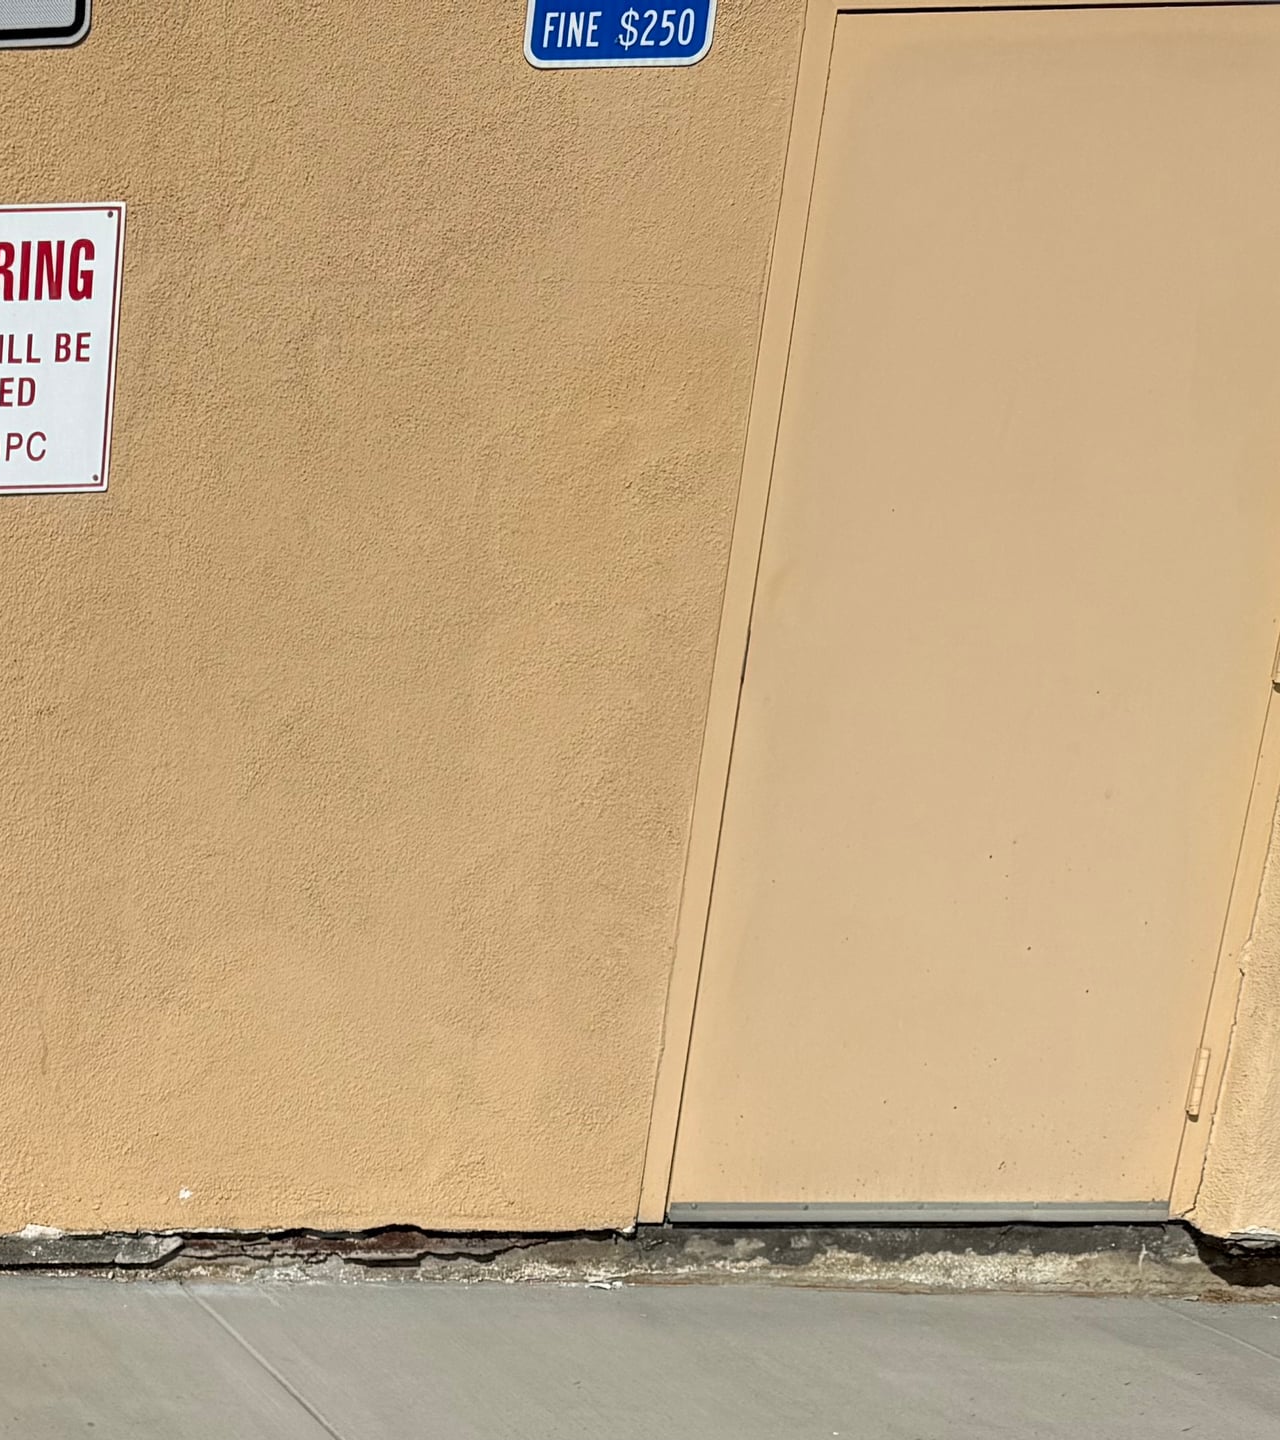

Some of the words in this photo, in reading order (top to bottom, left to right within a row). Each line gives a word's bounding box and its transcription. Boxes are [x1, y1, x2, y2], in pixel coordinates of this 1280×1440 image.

[543, 12, 601, 47] FINE
[619, 8, 694, 50] $250
[56, 333, 90, 362] BE
